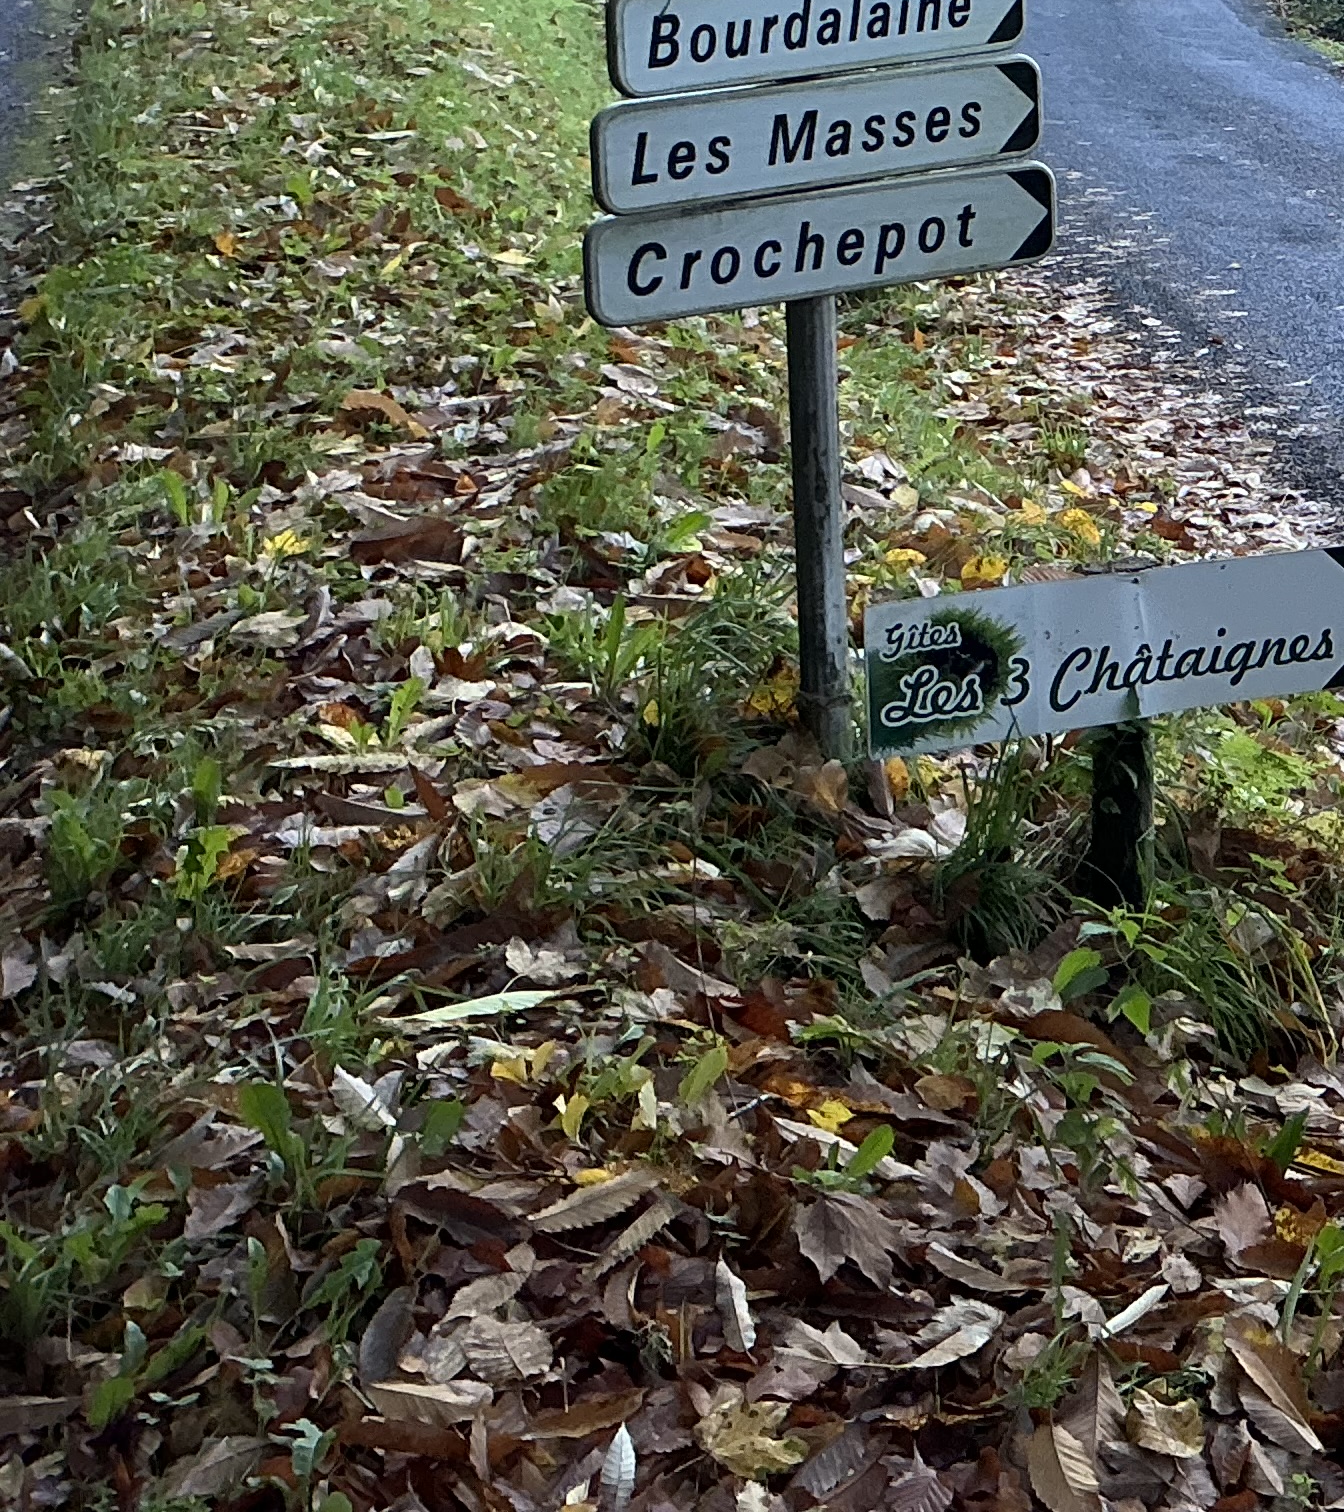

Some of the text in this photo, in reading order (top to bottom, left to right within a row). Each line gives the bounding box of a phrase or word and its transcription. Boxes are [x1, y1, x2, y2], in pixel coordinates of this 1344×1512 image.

[631, 99, 982, 185] Les Masses
[627, 203, 977, 296] Crochepot
[880, 627, 1334, 726] Les 3 Châtaignes
